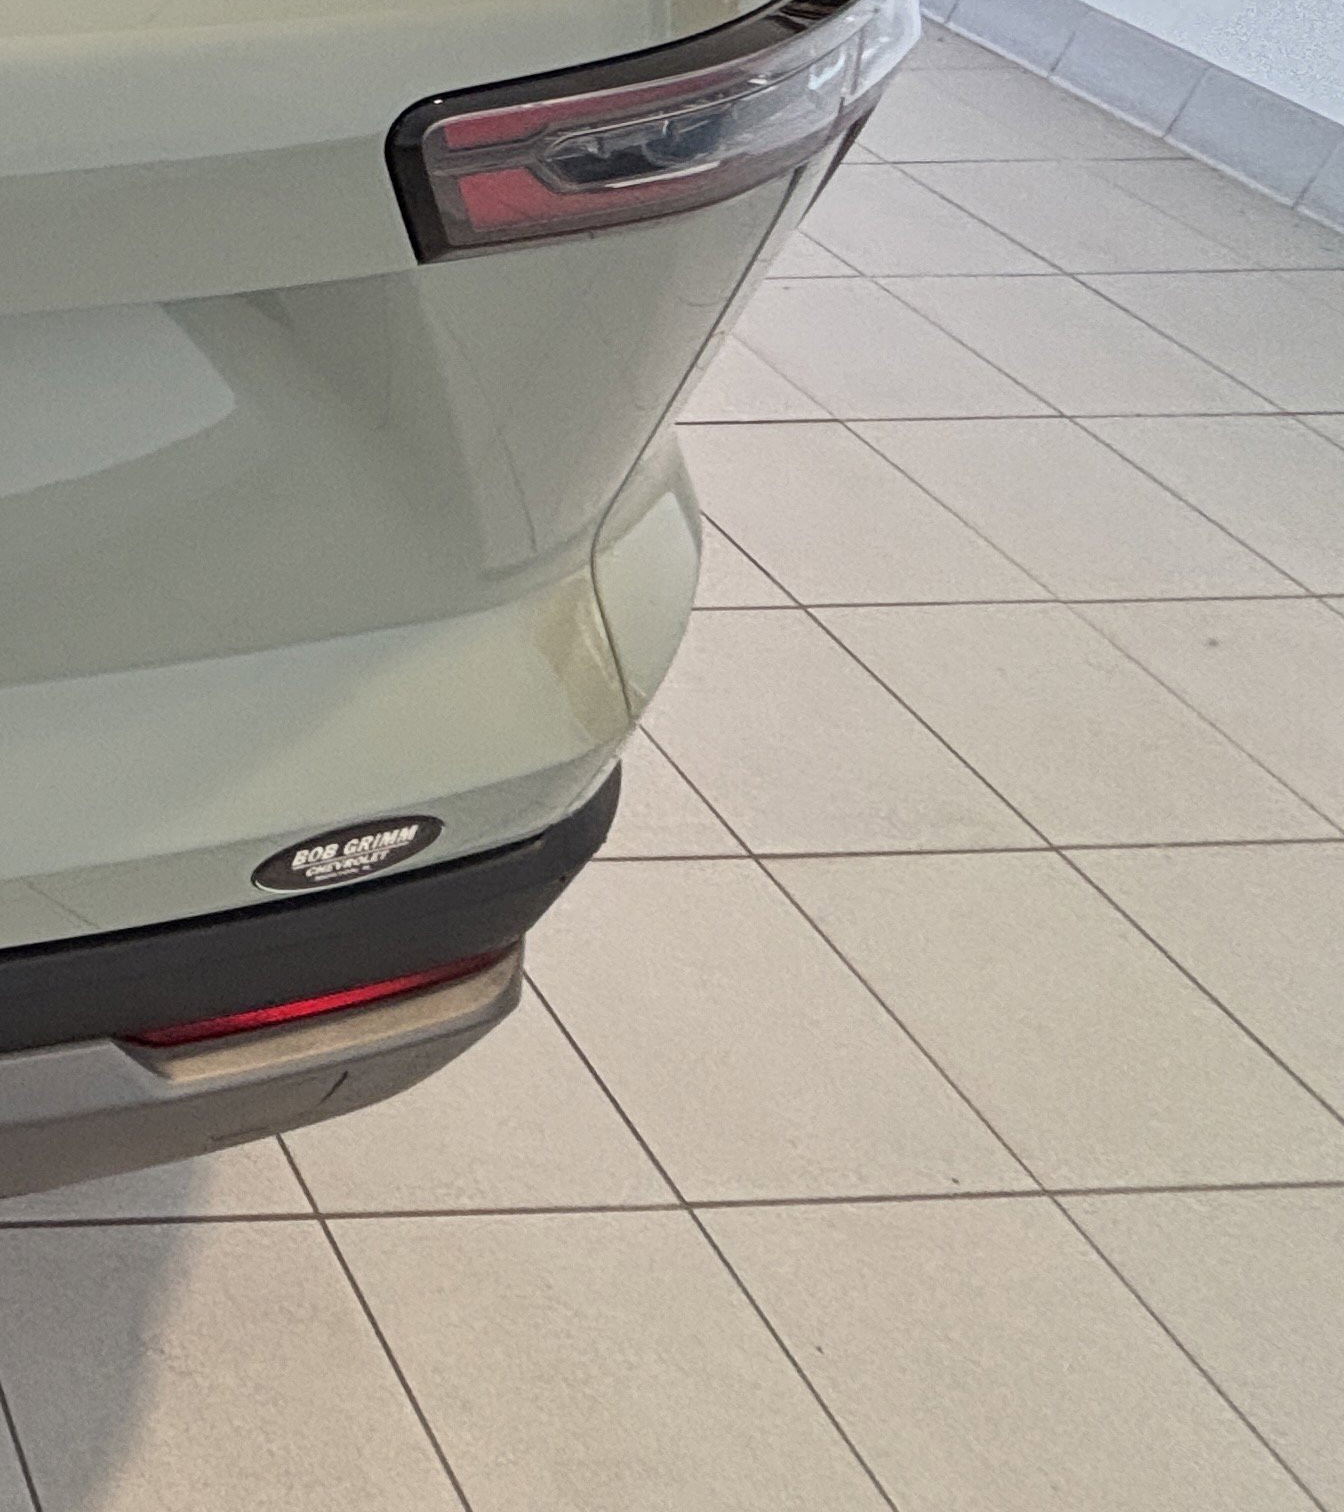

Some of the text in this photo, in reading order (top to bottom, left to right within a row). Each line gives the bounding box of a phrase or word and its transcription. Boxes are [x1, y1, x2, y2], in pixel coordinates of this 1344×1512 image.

[292, 824, 419, 867] BOB GRIMM
[305, 849, 391, 877] CHEVROLET
